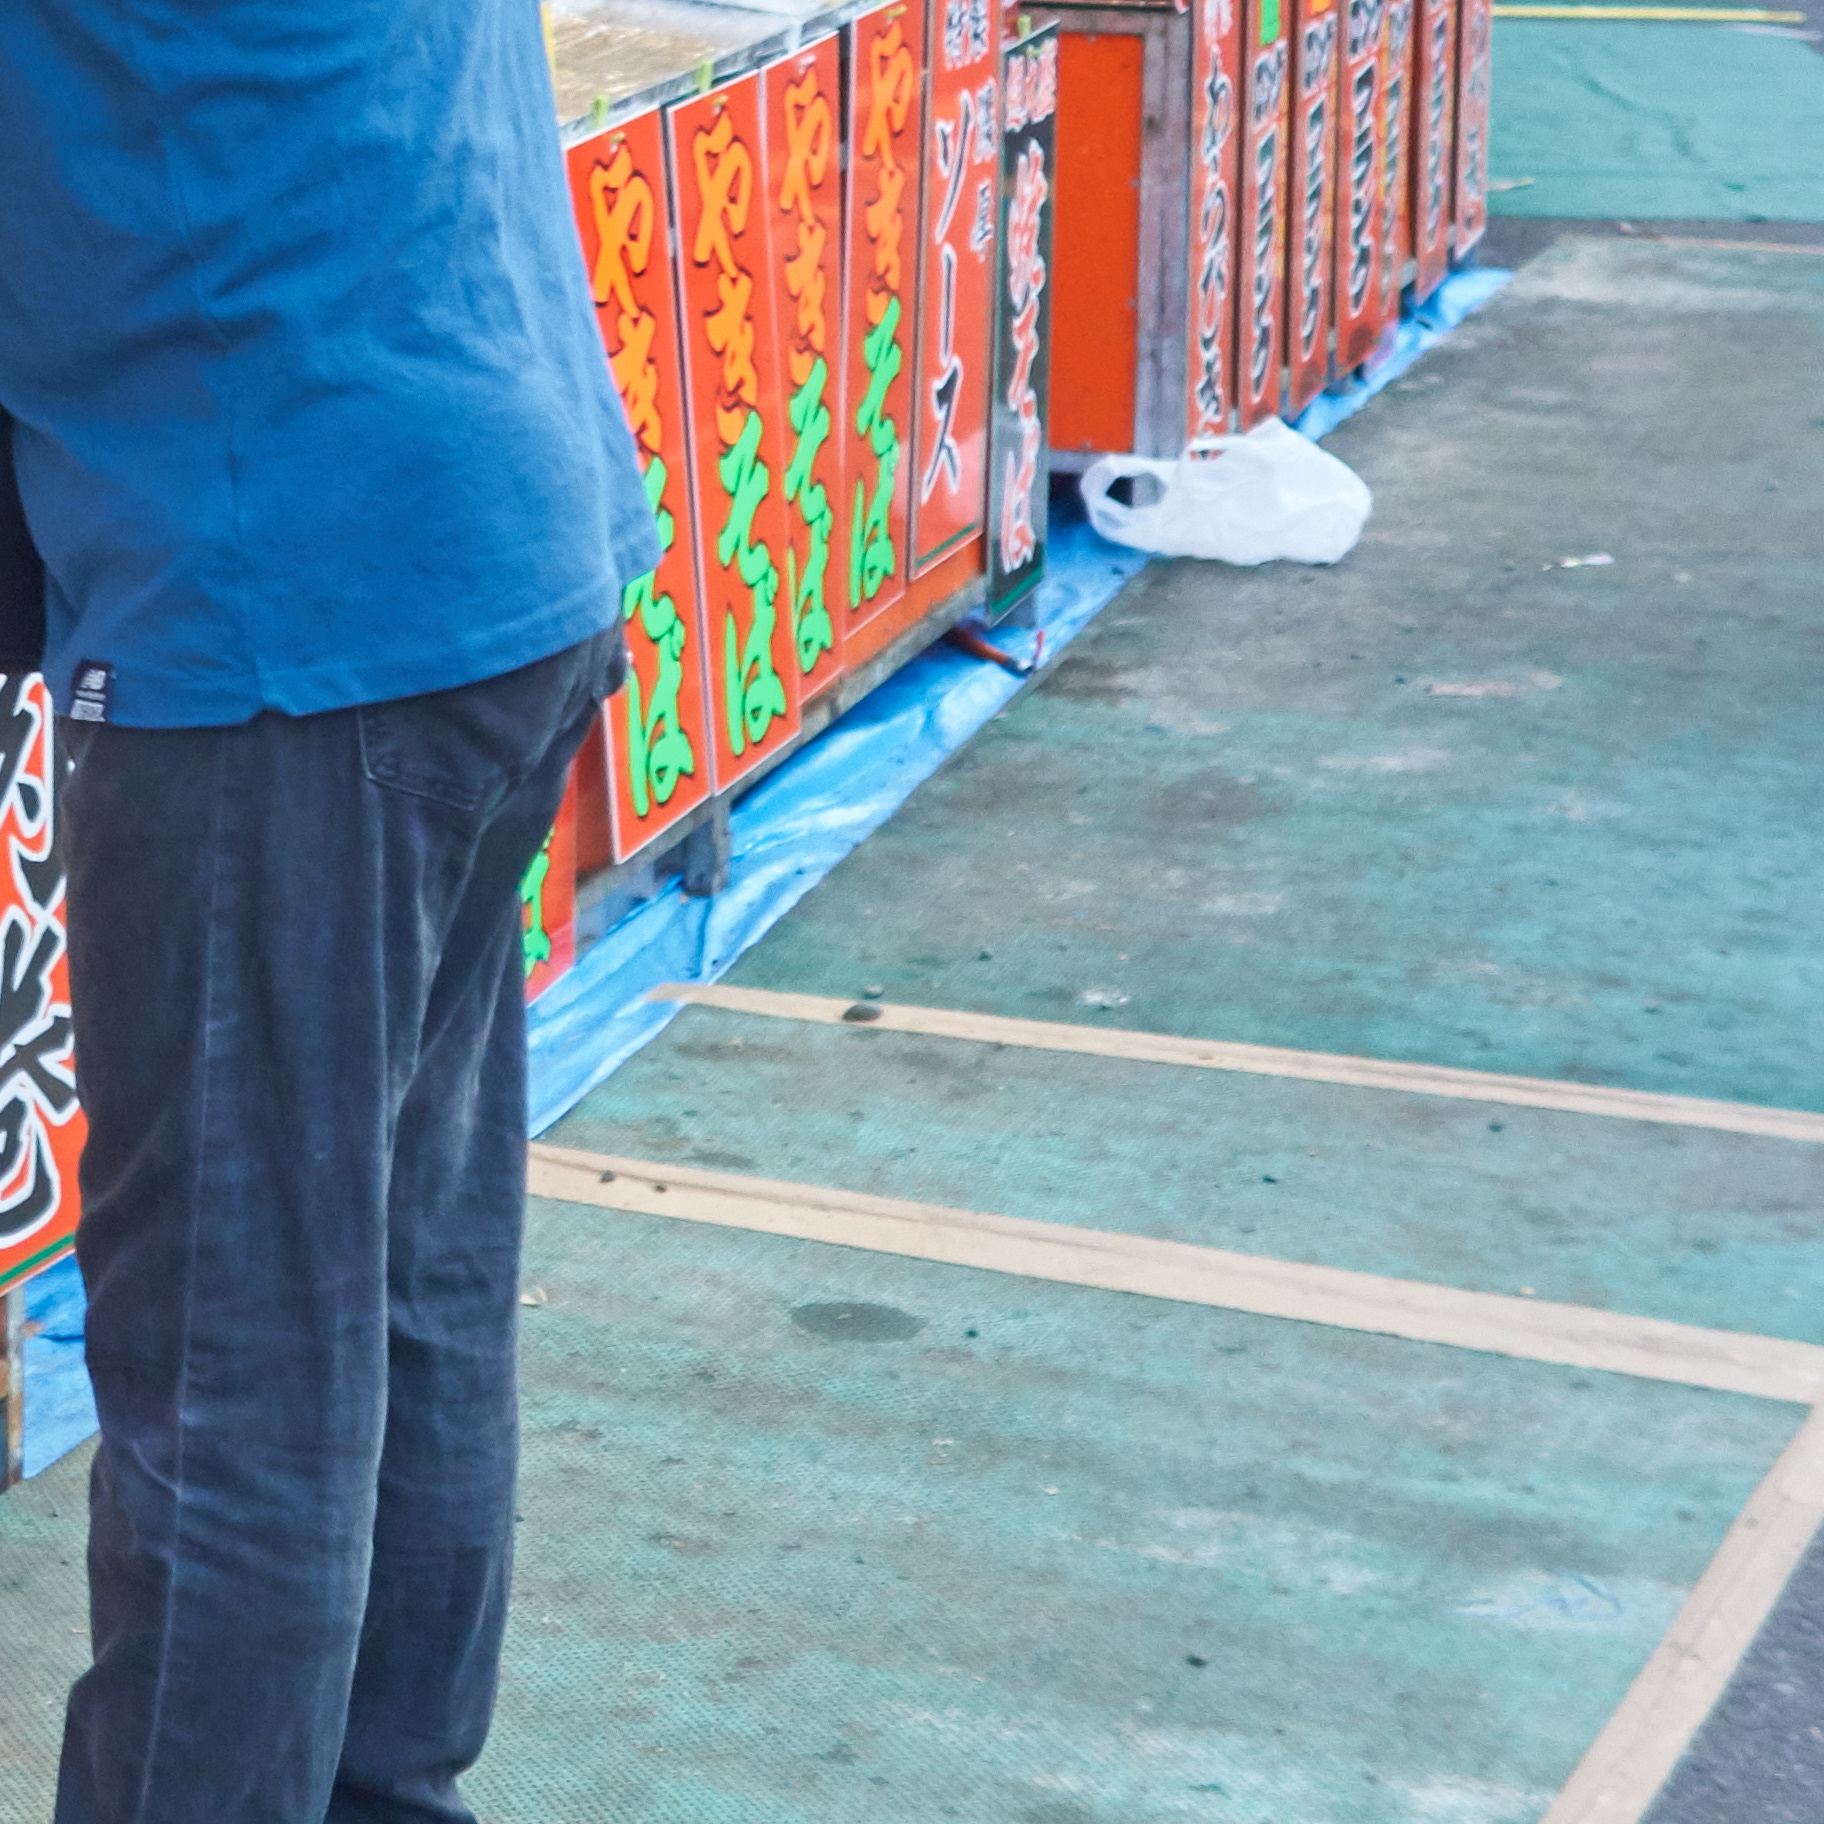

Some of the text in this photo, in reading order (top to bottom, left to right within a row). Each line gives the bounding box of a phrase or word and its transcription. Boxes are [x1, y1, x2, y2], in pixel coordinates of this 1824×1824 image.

[689, 109, 787, 760] やきそば
[782, 61, 835, 675] やきそば
[847, 18, 916, 611] やきそば
